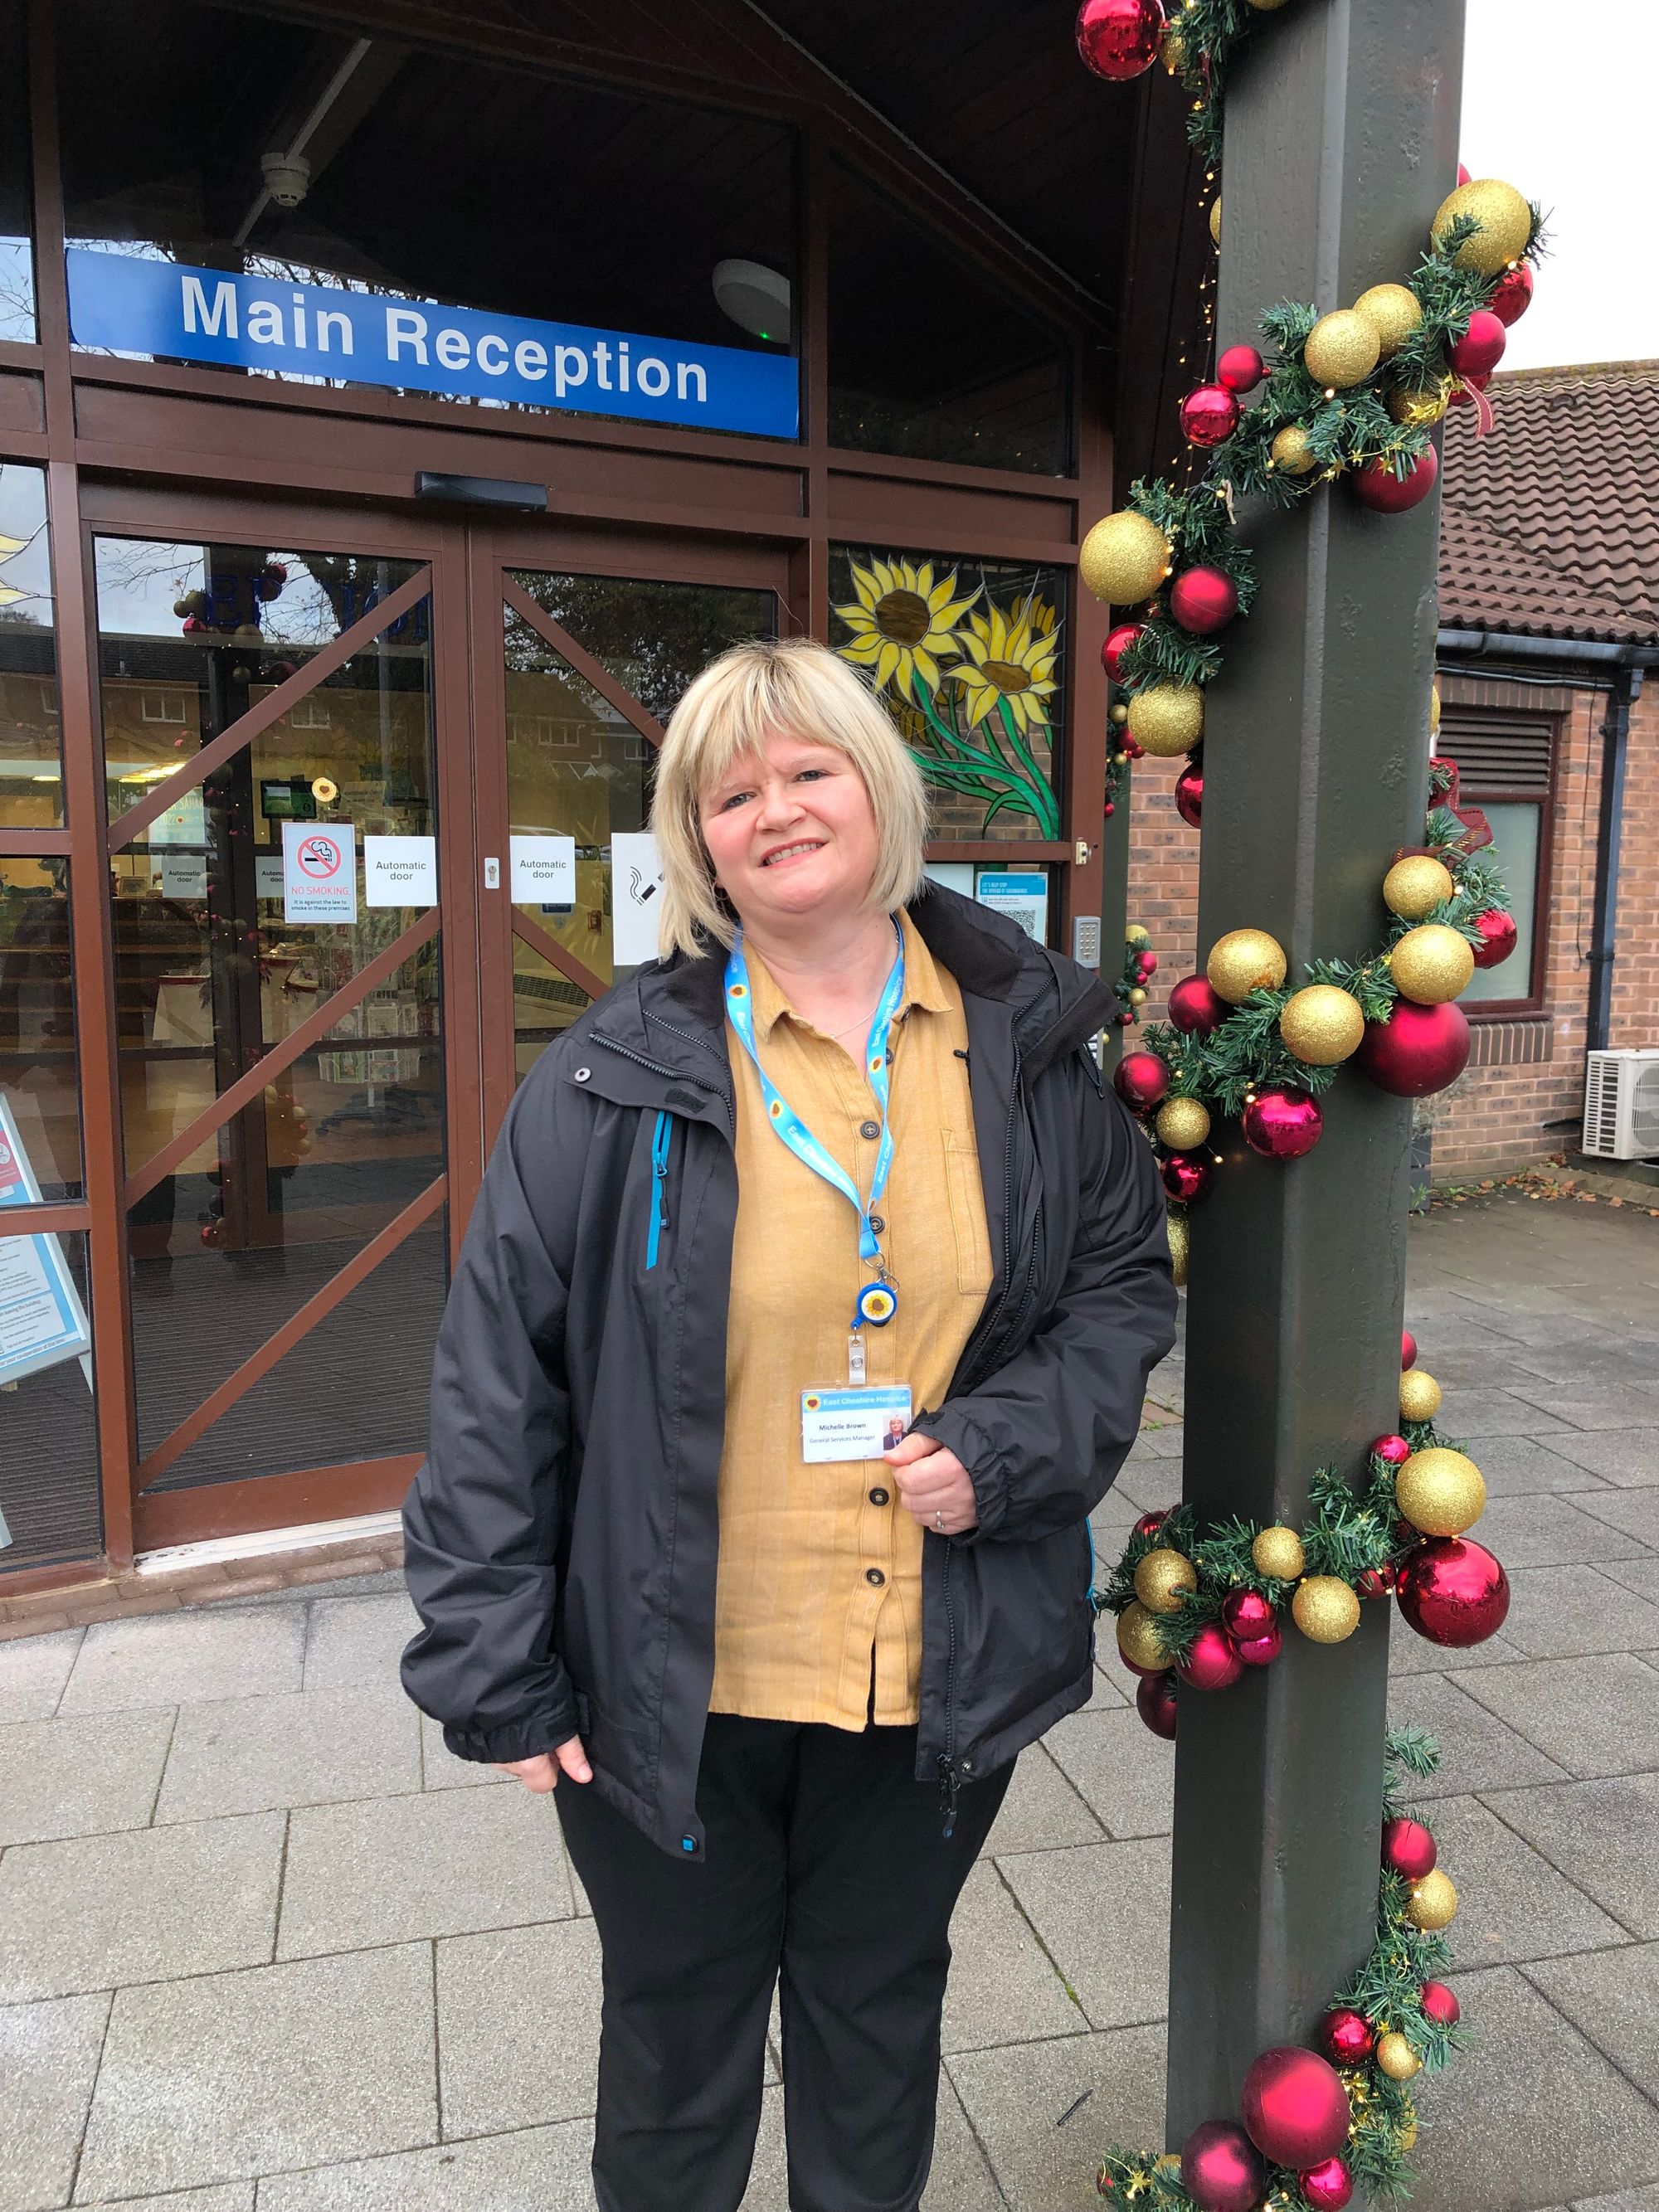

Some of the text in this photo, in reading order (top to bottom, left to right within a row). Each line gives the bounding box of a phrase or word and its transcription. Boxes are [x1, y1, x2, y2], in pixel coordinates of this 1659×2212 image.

[182, 275, 707, 402] Main Reception
[376, 861, 426, 870] Automatic
[520, 859, 567, 869] Automatic
[390, 872, 413, 881] door
[533, 870, 554, 879] door
[291, 887, 352, 896] NO SMOKING.
[887, 975, 903, 1006] Hospice
[878, 1160, 888, 1183] East
[841, 1396, 875, 1405] Cheshire
